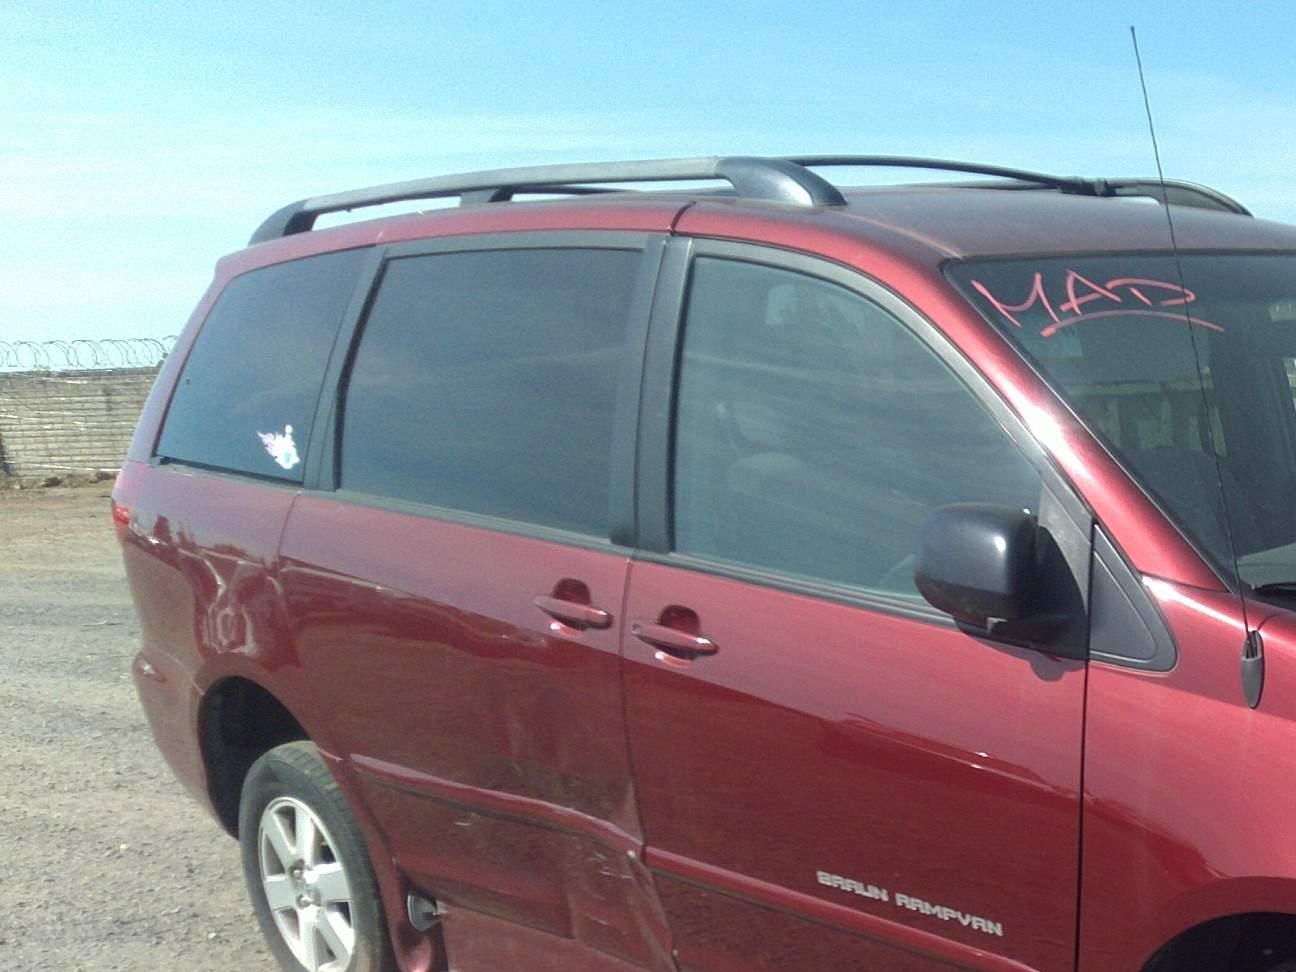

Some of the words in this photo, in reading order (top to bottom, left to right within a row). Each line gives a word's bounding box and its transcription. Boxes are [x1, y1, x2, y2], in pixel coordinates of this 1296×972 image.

[970, 268, 1197, 328] MAD
[816, 869, 889, 903] BRAUN
[895, 891, 1004, 937] RAMPVAN
